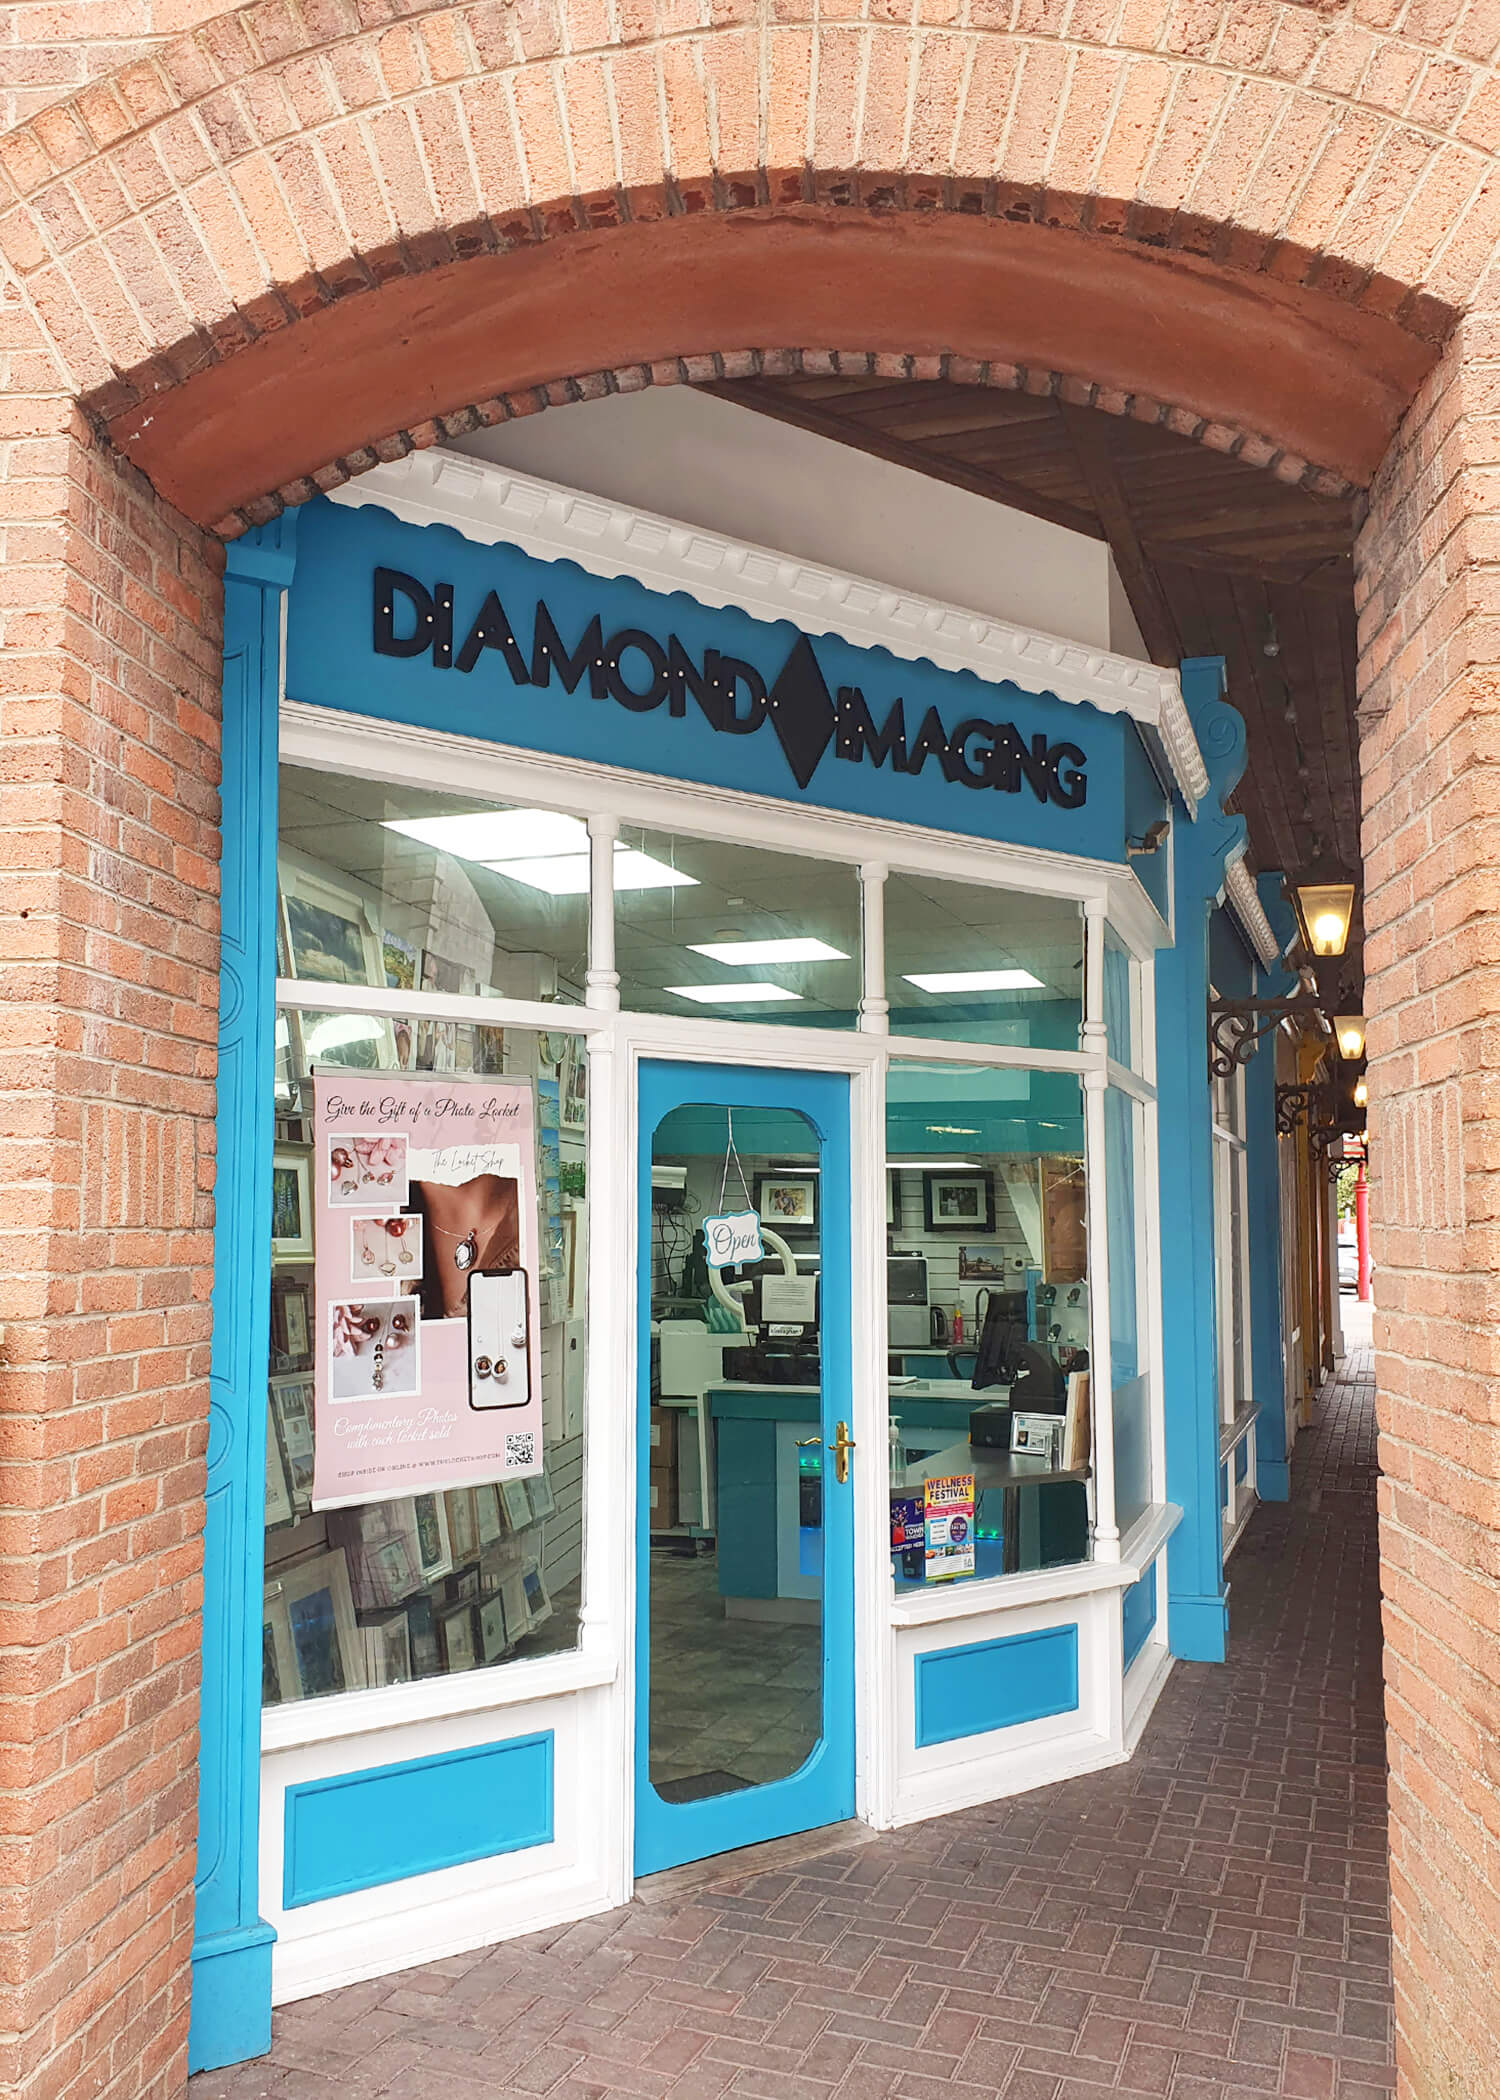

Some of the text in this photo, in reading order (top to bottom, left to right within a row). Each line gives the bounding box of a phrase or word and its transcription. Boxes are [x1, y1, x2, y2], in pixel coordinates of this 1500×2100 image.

[373, 566, 1088, 809] DIAMOND IMAGING
[324, 1095, 520, 1124] Give the Gift of a Photo Locket
[432, 1150, 504, 1174] The Locket Shop
[713, 1223, 756, 1260] Open
[417, 1407, 458, 1426] Photos
[346, 1434, 368, 1449] with
[429, 1425, 452, 1441] sold
[928, 1476, 972, 1490] WELLNESS
[930, 1487, 969, 1500] FESTIVAL
